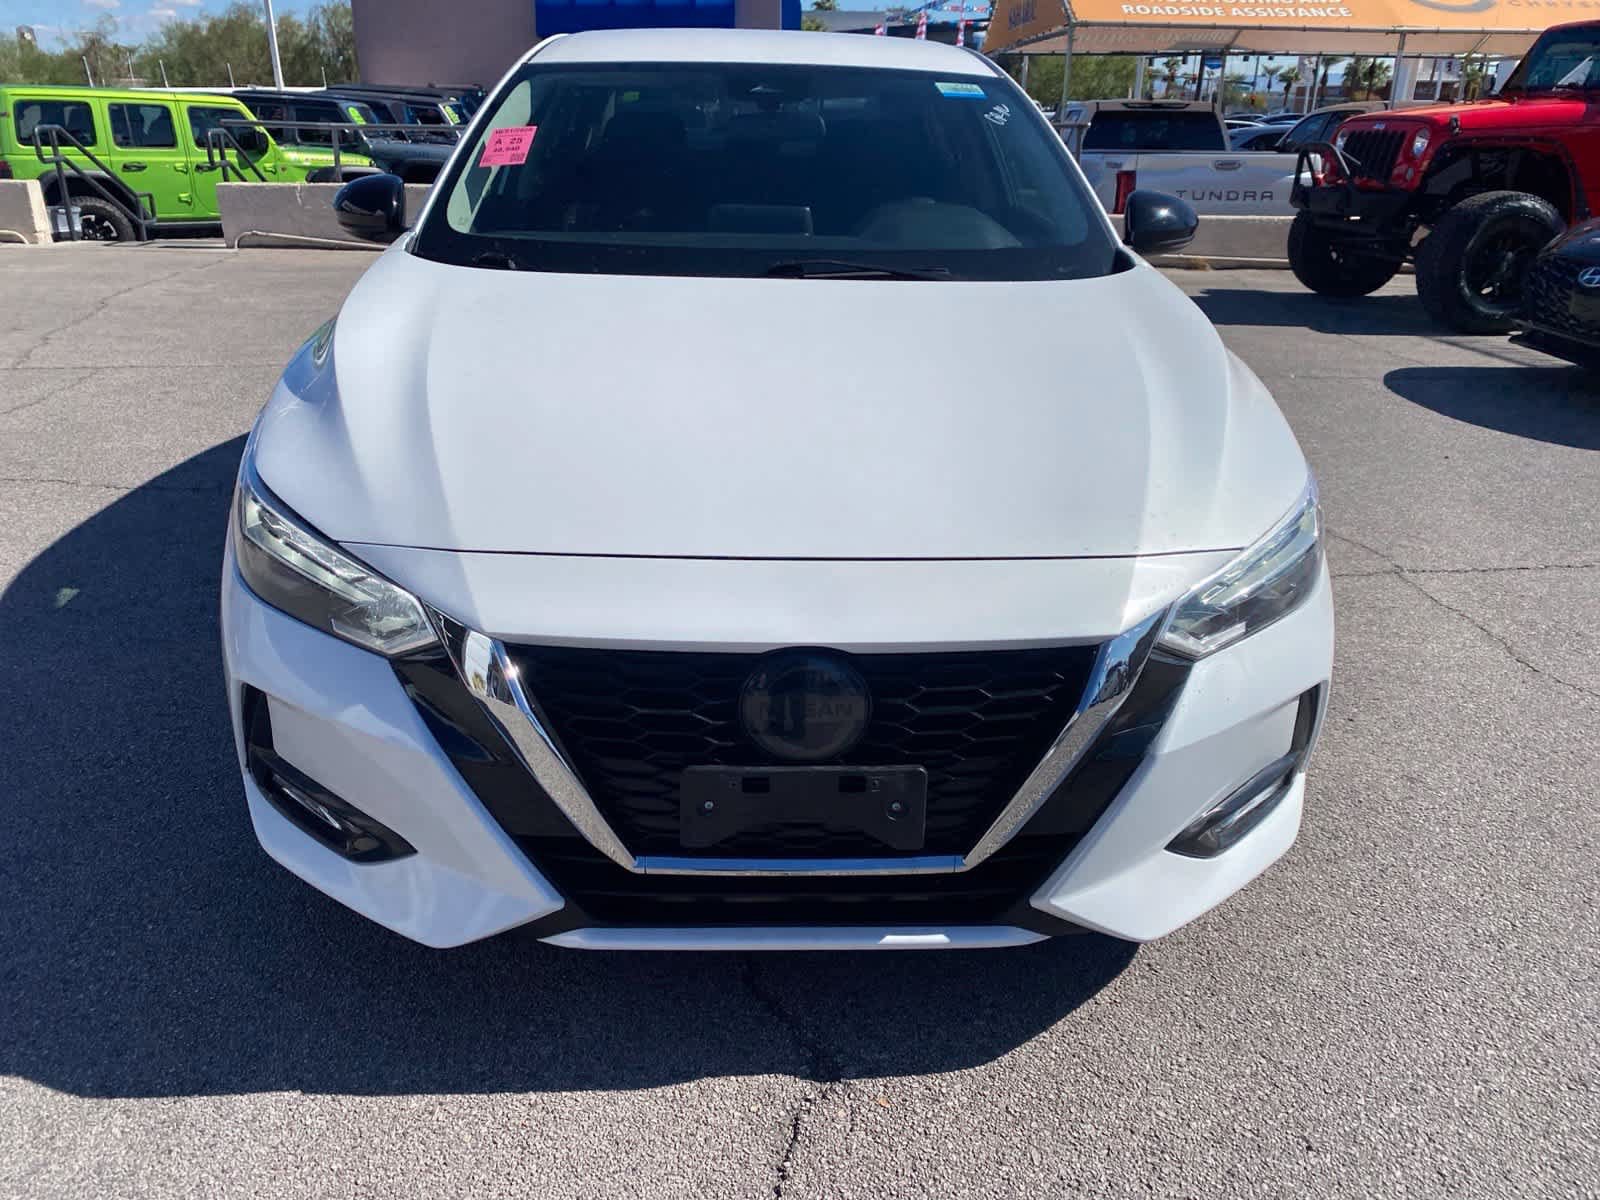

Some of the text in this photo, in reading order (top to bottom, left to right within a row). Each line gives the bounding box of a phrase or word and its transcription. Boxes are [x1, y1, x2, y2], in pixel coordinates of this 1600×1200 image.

[1121, 4, 1352, 17] ROADSIDE ASSISTANCE
[1175, 190, 1273, 201] TUNDRA
